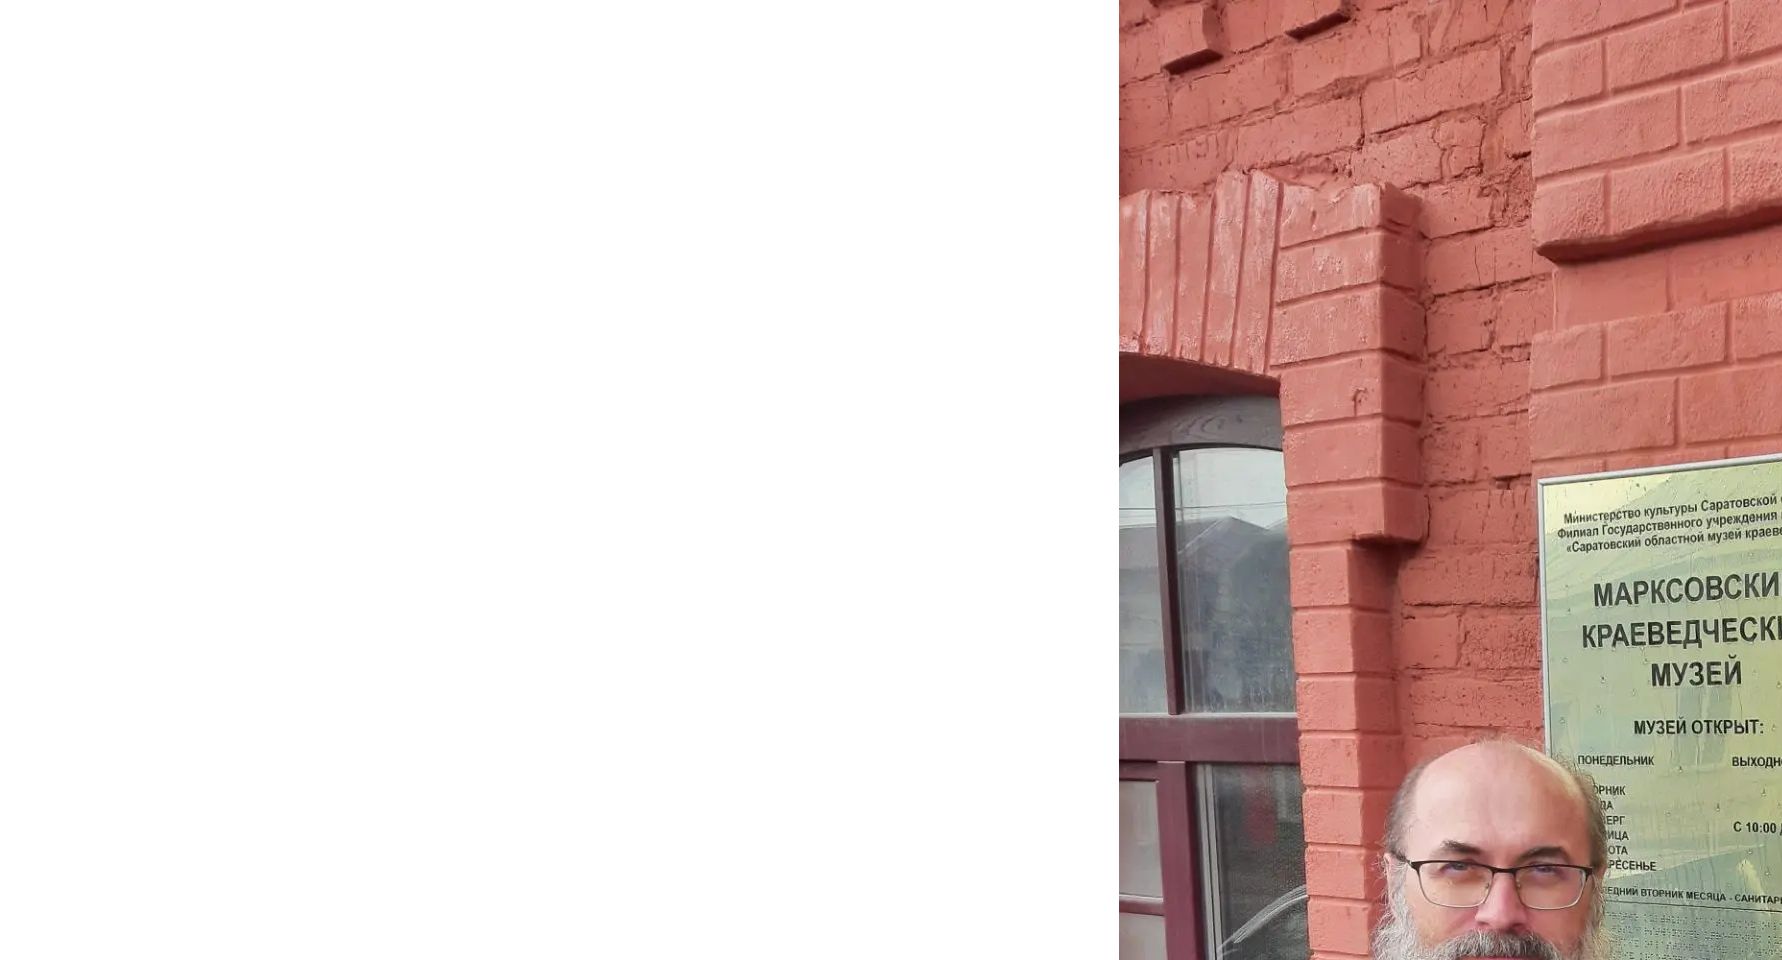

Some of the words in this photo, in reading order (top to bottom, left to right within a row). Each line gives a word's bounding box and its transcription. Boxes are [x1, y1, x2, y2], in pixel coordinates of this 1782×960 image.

[1564, 509, 1640, 524] Министерство
[1644, 503, 1697, 519] культуры
[1701, 493, 1777, 512] Саратовской
[1557, 527, 1599, 539] Филиал
[1602, 518, 1703, 537] Государственного
[1706, 511, 1777, 529] учреждения
[1566, 537, 1641, 553] «Саратовский
[1645, 531, 1704, 546] областной
[1707, 527, 1742, 543] музей
[1651, 654, 1742, 687] МУЗЕЙ
[1634, 716, 1686, 734] МУЗЕЙ
[1691, 719, 1763, 734] ОТКРЫТ:
[1578, 755, 1655, 767] ПОНЕДЕЛЬНИК
[1746, 822, 1776, 833] 10:00
[1608, 859, 1657, 871] РЕСЕНЬЕ
[1606, 885, 1639, 897] ЕДНИЙ
[1641, 888, 1684, 899] ВТОРНИК
[1686, 891, 1726, 903] МЕСЯЦА
